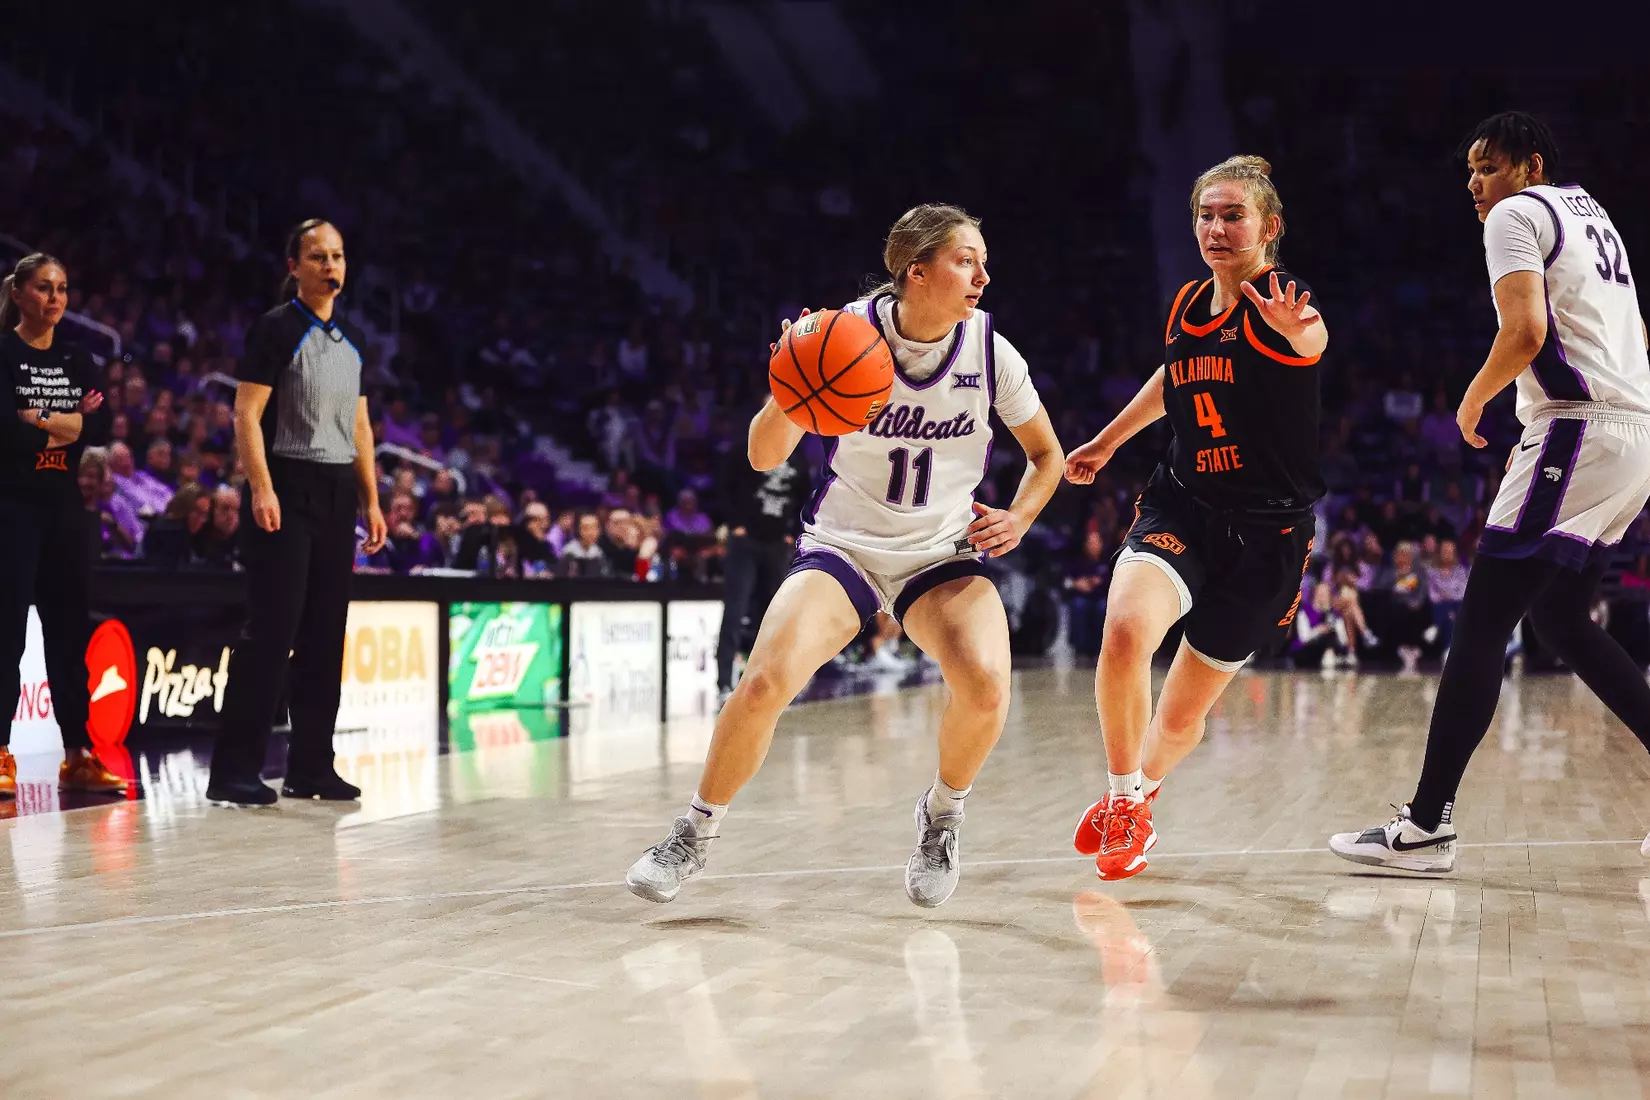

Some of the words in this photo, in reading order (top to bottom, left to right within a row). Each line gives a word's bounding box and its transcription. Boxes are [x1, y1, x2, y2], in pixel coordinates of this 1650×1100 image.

[1586, 224, 1630, 288] 32
[30, 375, 70, 386] DREAMS
[39, 367, 64, 376] YOUR
[1169, 355, 1235, 388] KLAHOMA
[28, 398, 51, 408] THEY
[41, 386, 70, 397] SCARE
[70, 387, 83, 397] YO
[1193, 392, 1227, 438] 4
[1196, 445, 1244, 473] STATE
[885, 446, 932, 507] 11
[12, 681, 51, 721] NG
[139, 646, 214, 725] Pizza
